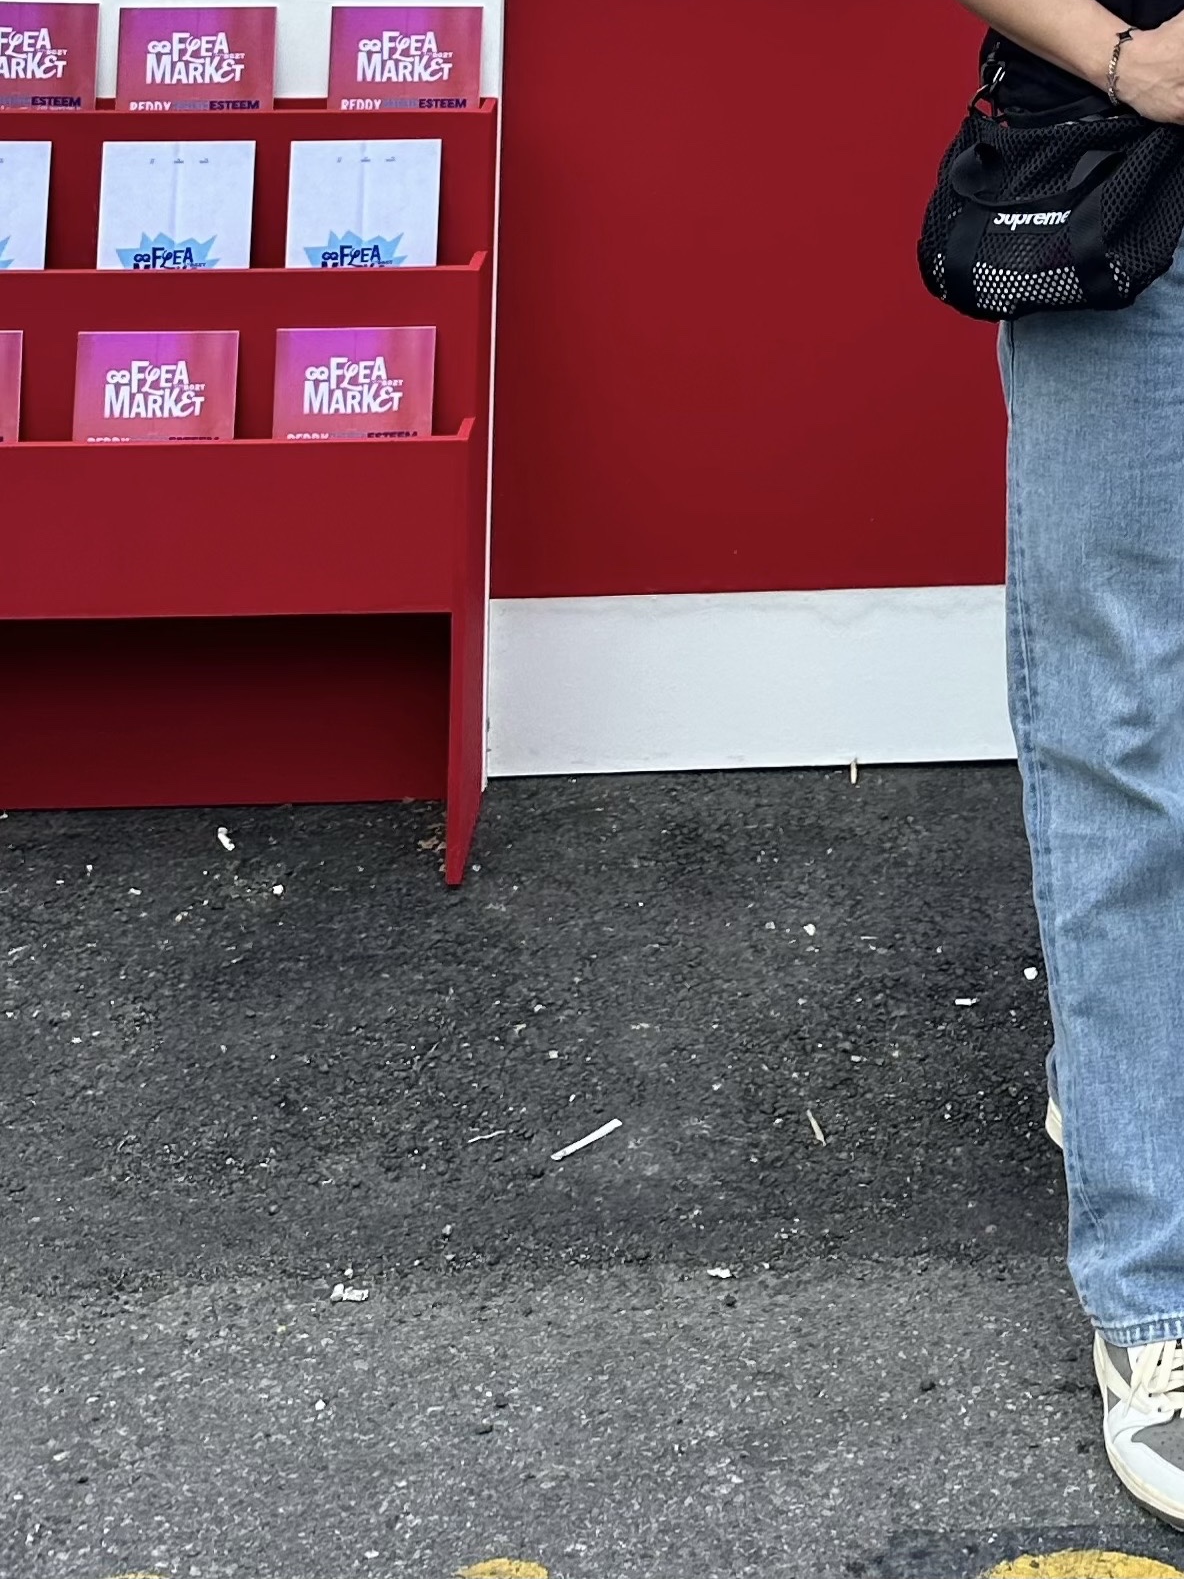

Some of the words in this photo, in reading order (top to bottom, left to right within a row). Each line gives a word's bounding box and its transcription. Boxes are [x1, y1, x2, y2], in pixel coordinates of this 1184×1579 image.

[172, 31, 229, 63] FLEA
[382, 30, 438, 62] FLEA
[0, 52, 67, 80] ARKET
[146, 53, 245, 84] MARKET
[356, 51, 453, 82] MARKET
[31, 96, 82, 107] ESTEEM
[209, 100, 260, 110] ESTEEM
[418, 98, 467, 109] ESTEEM
[993, 209, 1072, 231] Supreme
[151, 246, 194, 269] FLEA
[339, 244, 381, 267] FLEA
[106, 370, 130, 384] GQ
[131, 360, 189, 395] FLEA
[305, 366, 329, 380] GQ
[330, 356, 388, 391] FLEA
[104, 383, 205, 418] MARKET
[303, 380, 403, 415] MARKET
